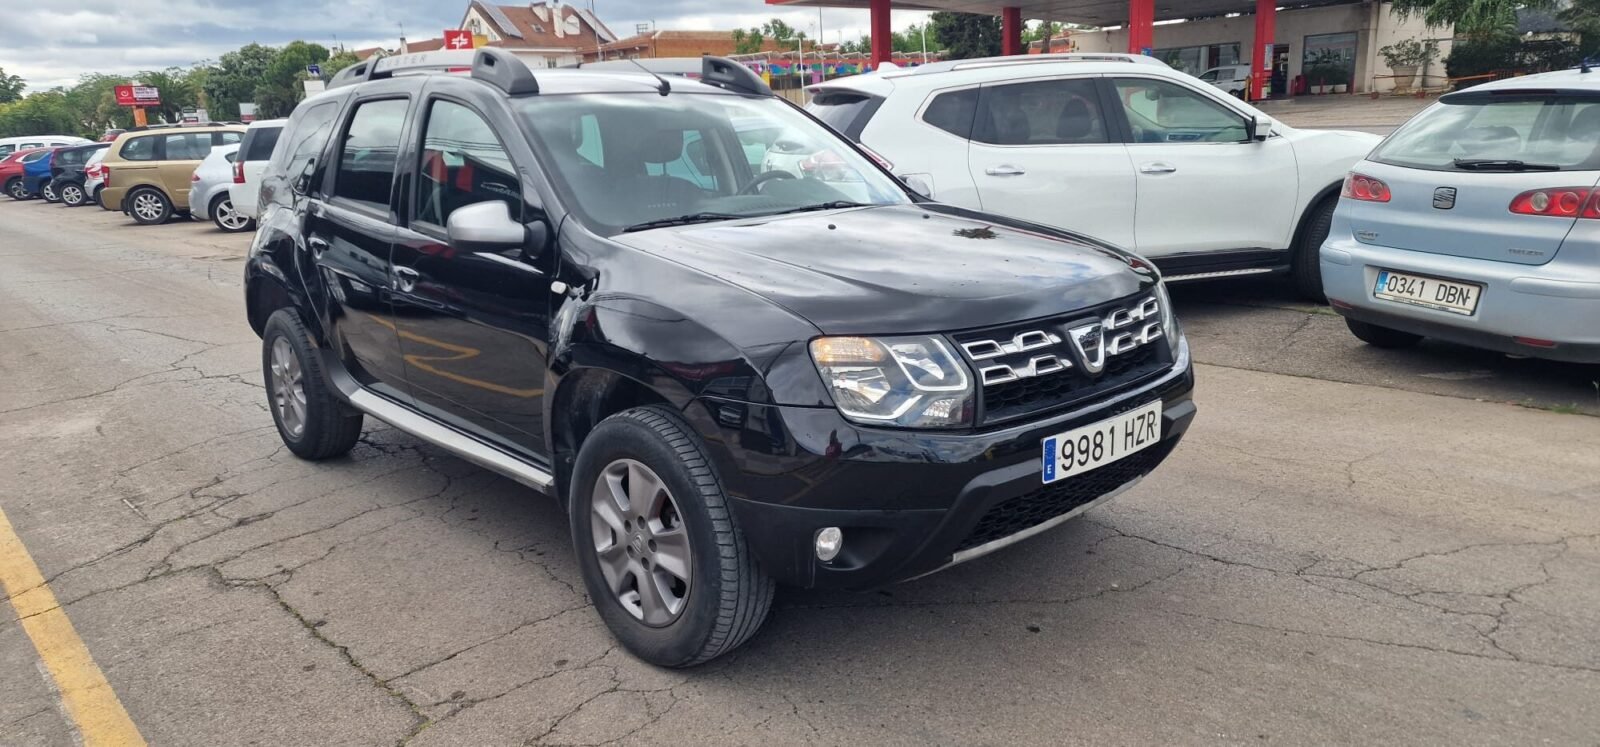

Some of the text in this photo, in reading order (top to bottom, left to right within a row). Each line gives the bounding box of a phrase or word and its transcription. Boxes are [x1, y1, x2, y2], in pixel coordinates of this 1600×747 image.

[1387, 275, 1426, 298] 0341
[1434, 283, 1470, 306] DBN
[1061, 410, 1156, 472] 9981 HZR
[1047, 464, 1052, 474] E
